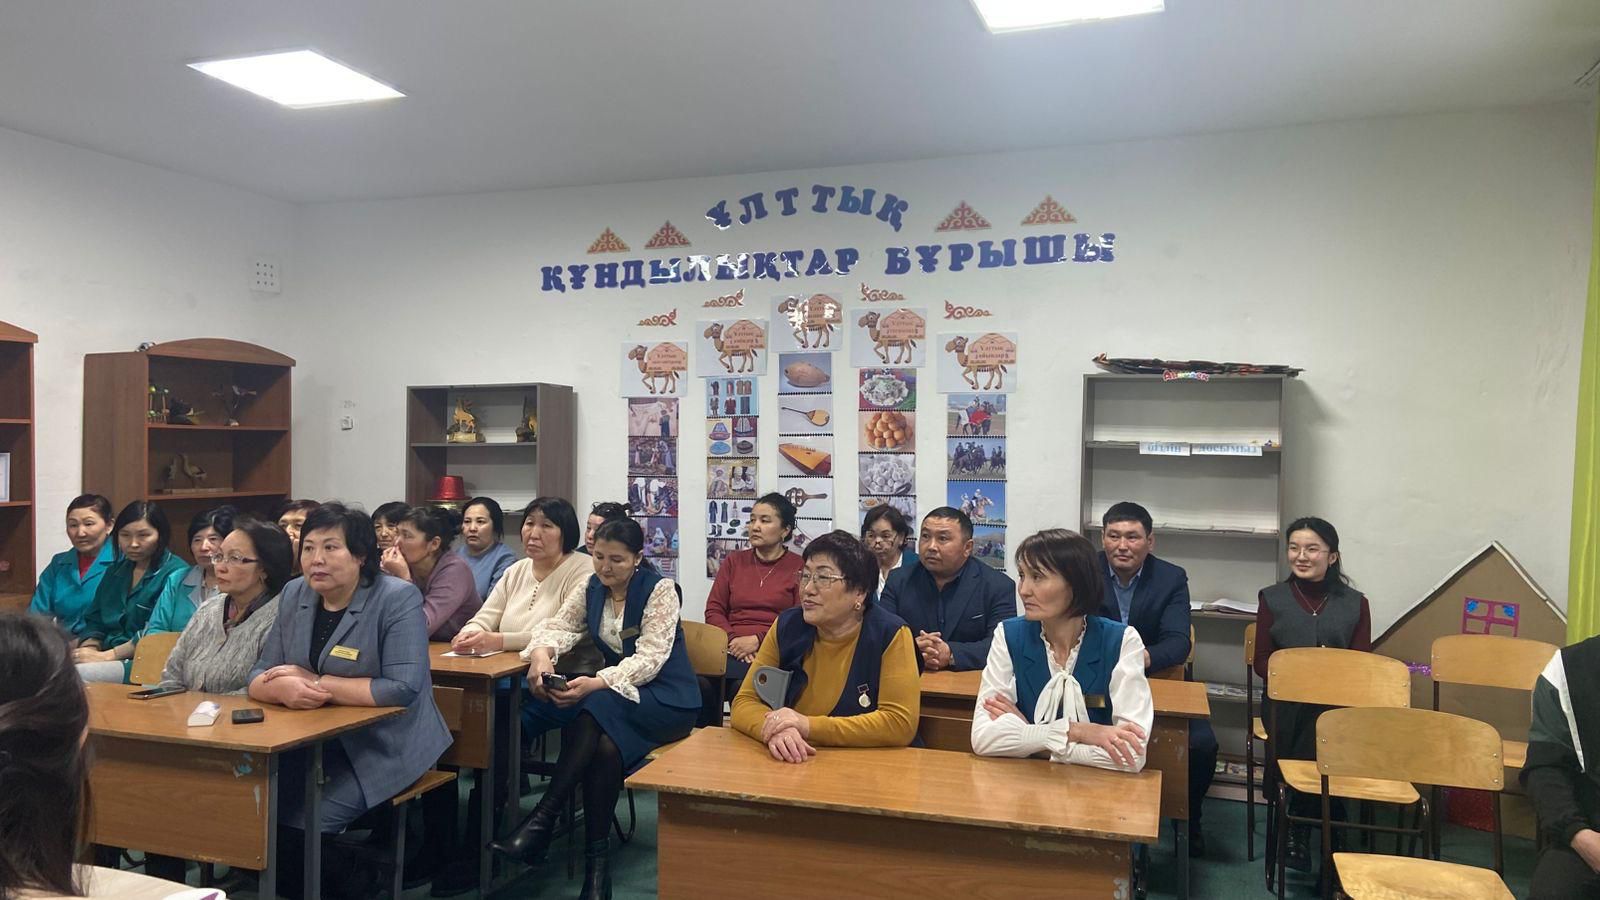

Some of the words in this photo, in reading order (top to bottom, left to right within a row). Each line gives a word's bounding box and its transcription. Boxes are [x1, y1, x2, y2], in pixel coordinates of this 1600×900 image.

[705, 184, 908, 232] ҰЛТТЫҚ
[541, 247, 859, 293] ҚҰНДЫЛЫҚТАР
[885, 233, 1116, 275] БҰРЫШЫ
